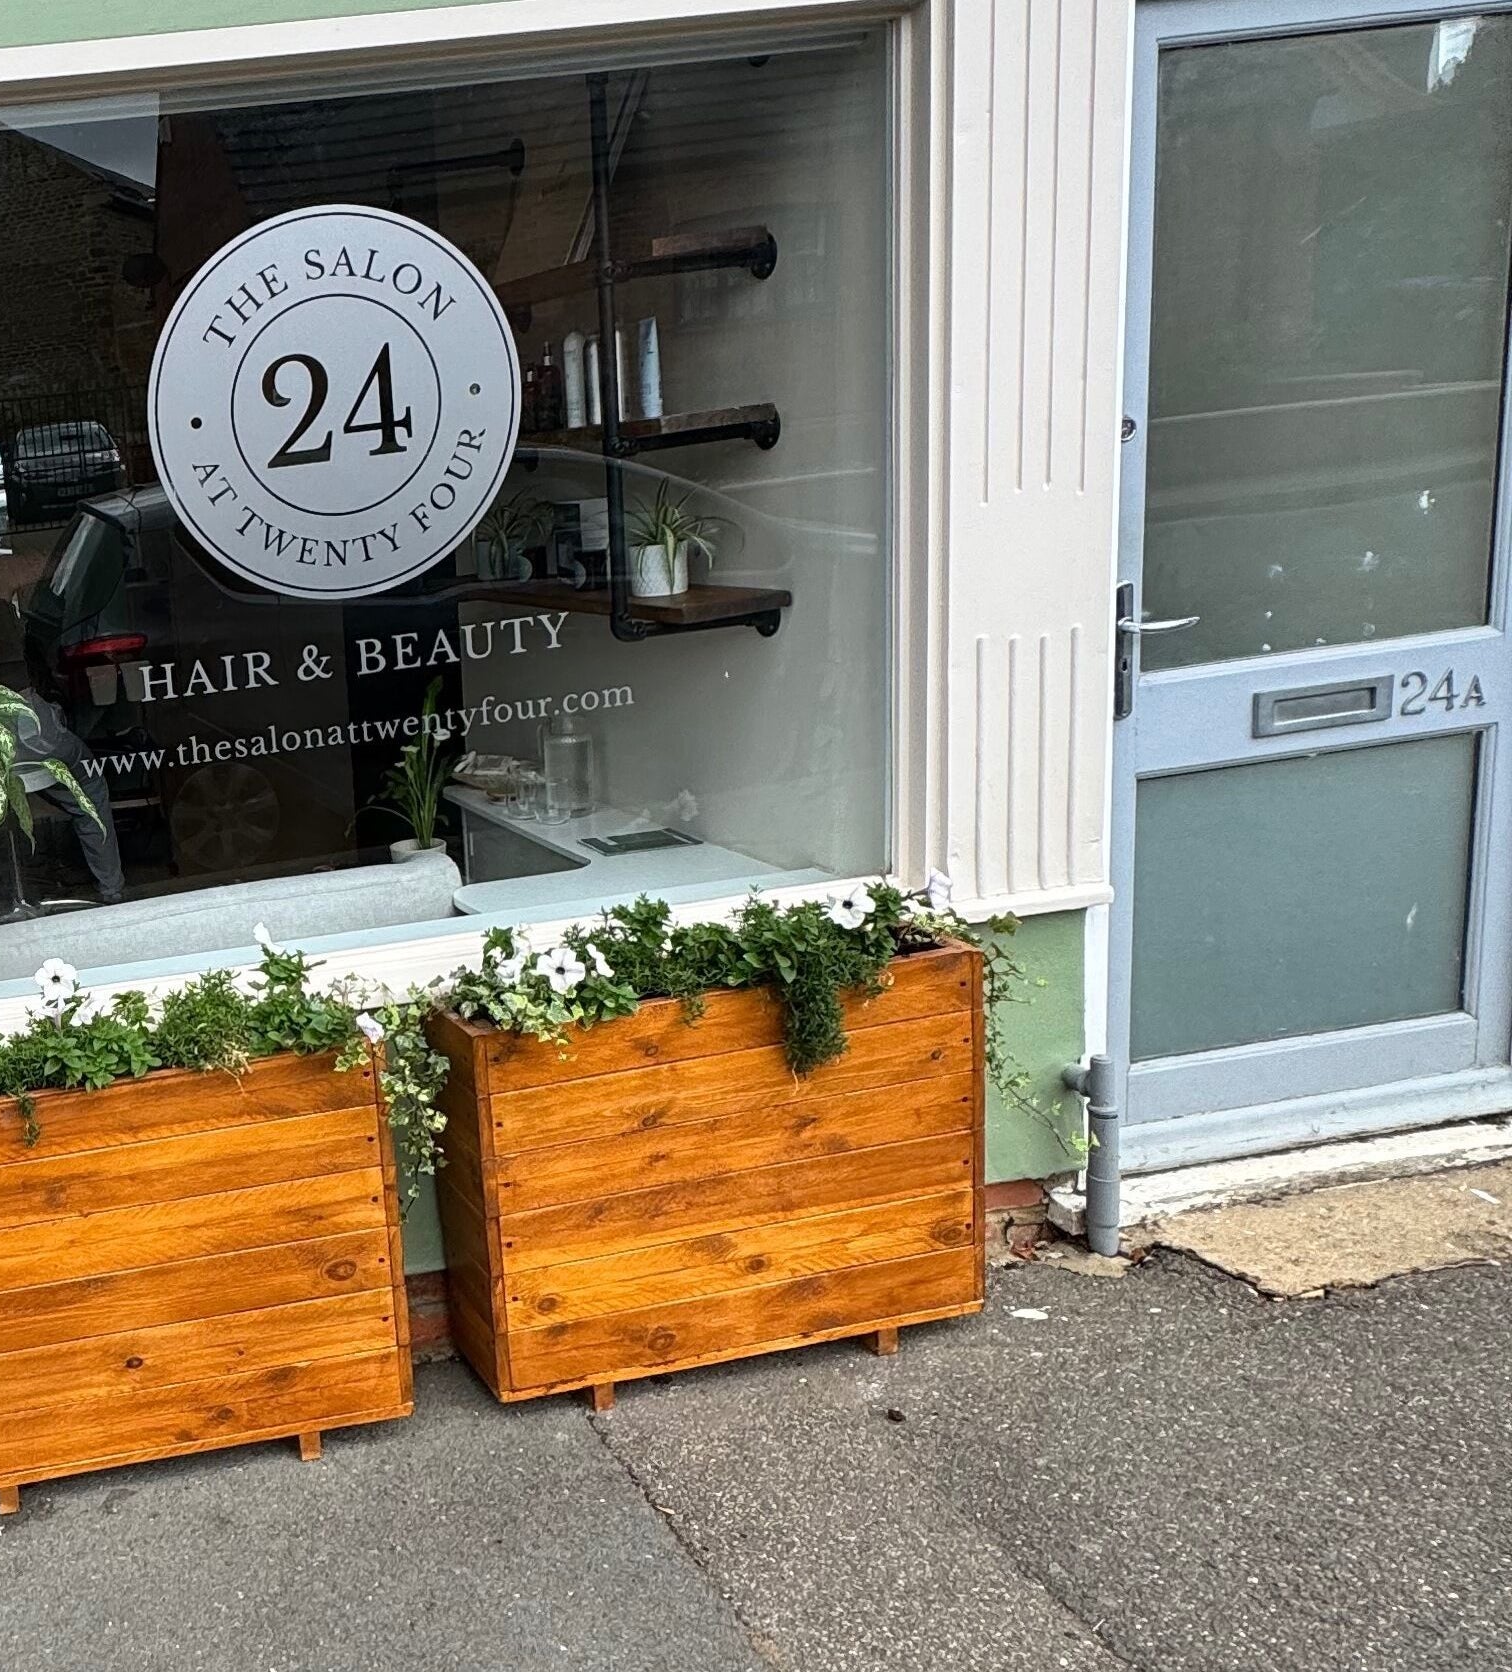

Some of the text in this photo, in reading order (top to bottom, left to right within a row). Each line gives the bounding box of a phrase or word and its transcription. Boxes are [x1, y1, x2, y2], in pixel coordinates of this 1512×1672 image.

[202, 245, 457, 350] THE SALON
[261, 341, 414, 470] 24
[191, 426, 487, 568] AT TWENTY FOUR
[139, 611, 571, 703] HAIR & BEAUTY
[1399, 666, 1487, 717] 24A
[80, 682, 635, 779] www.thesalonattwentyfour.com
